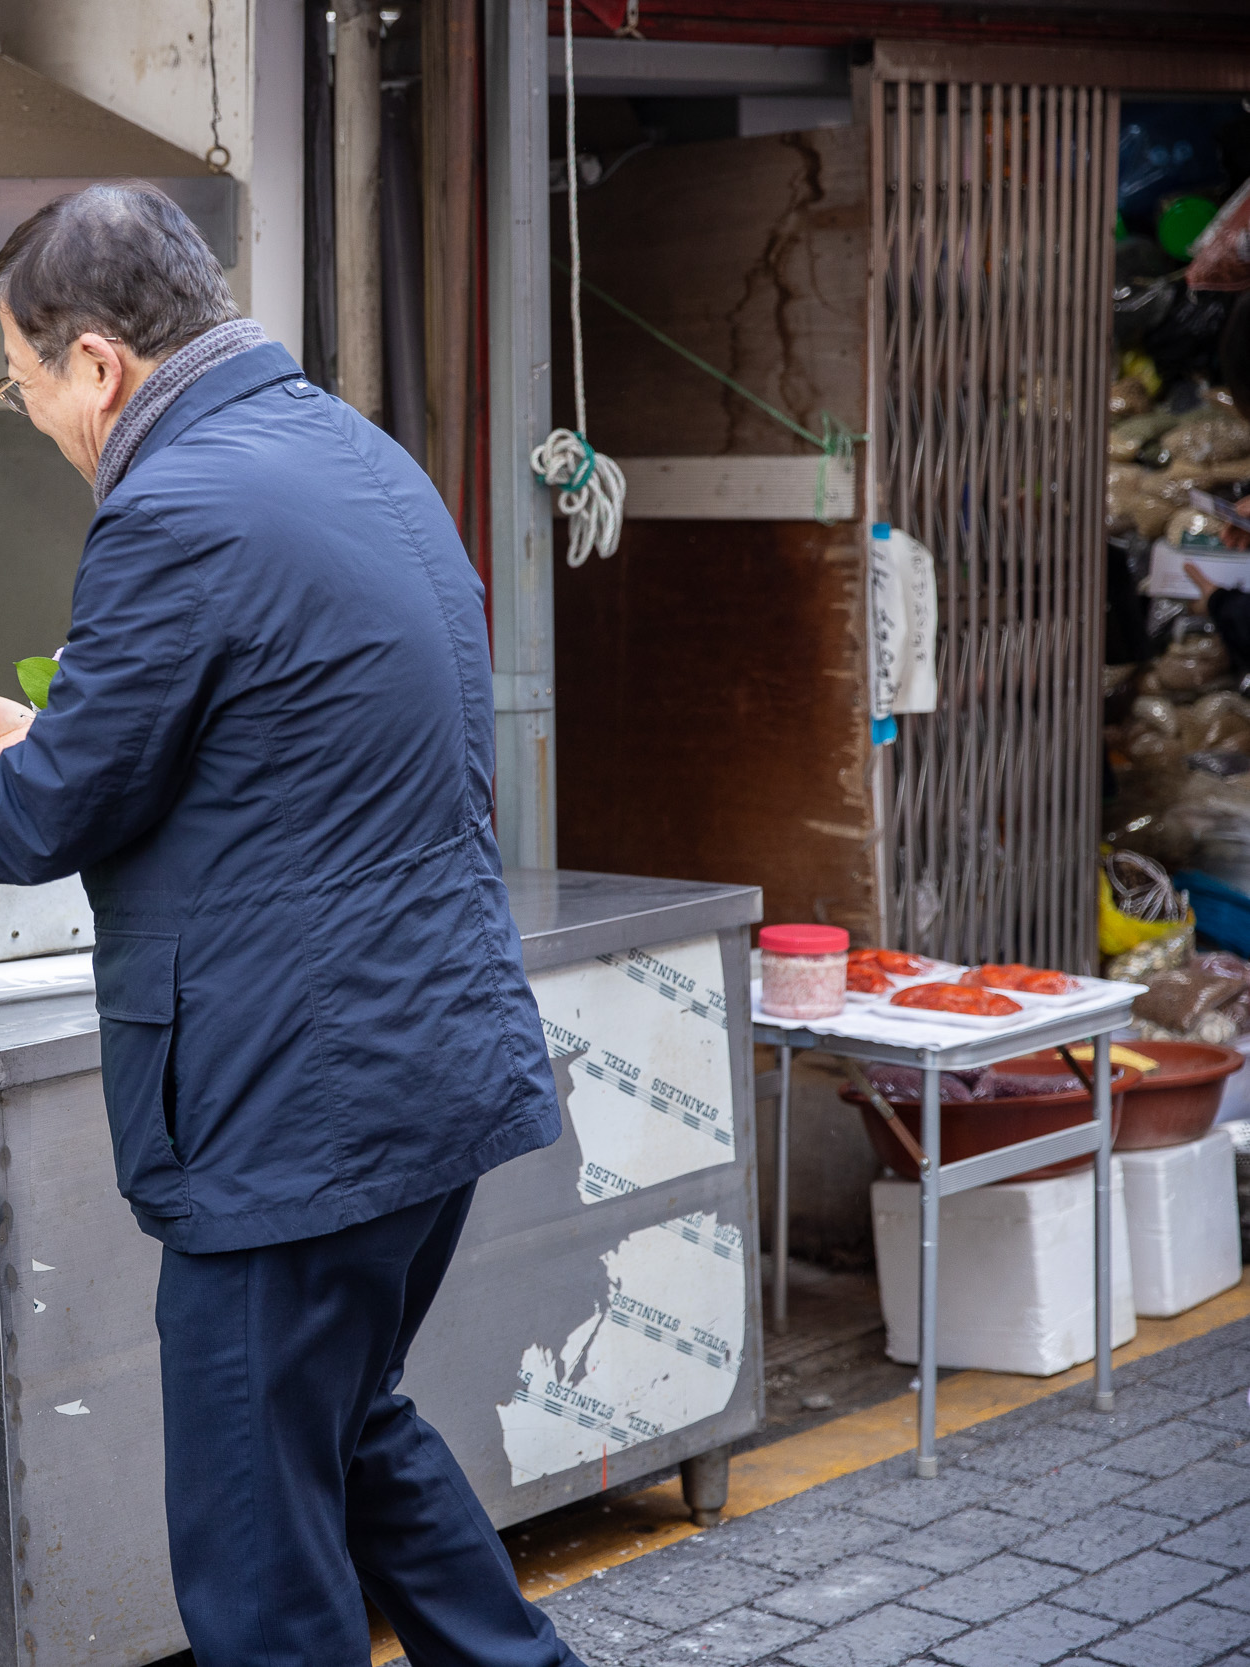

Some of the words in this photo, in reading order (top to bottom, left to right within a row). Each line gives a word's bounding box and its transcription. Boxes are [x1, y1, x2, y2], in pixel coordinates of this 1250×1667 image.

[627, 947, 697, 993] STAINLESS
[651, 1078, 719, 1122] STAINLESS
[612, 1292, 682, 1333] STAINLESS
[545, 1381, 616, 1420] STAINLESS
